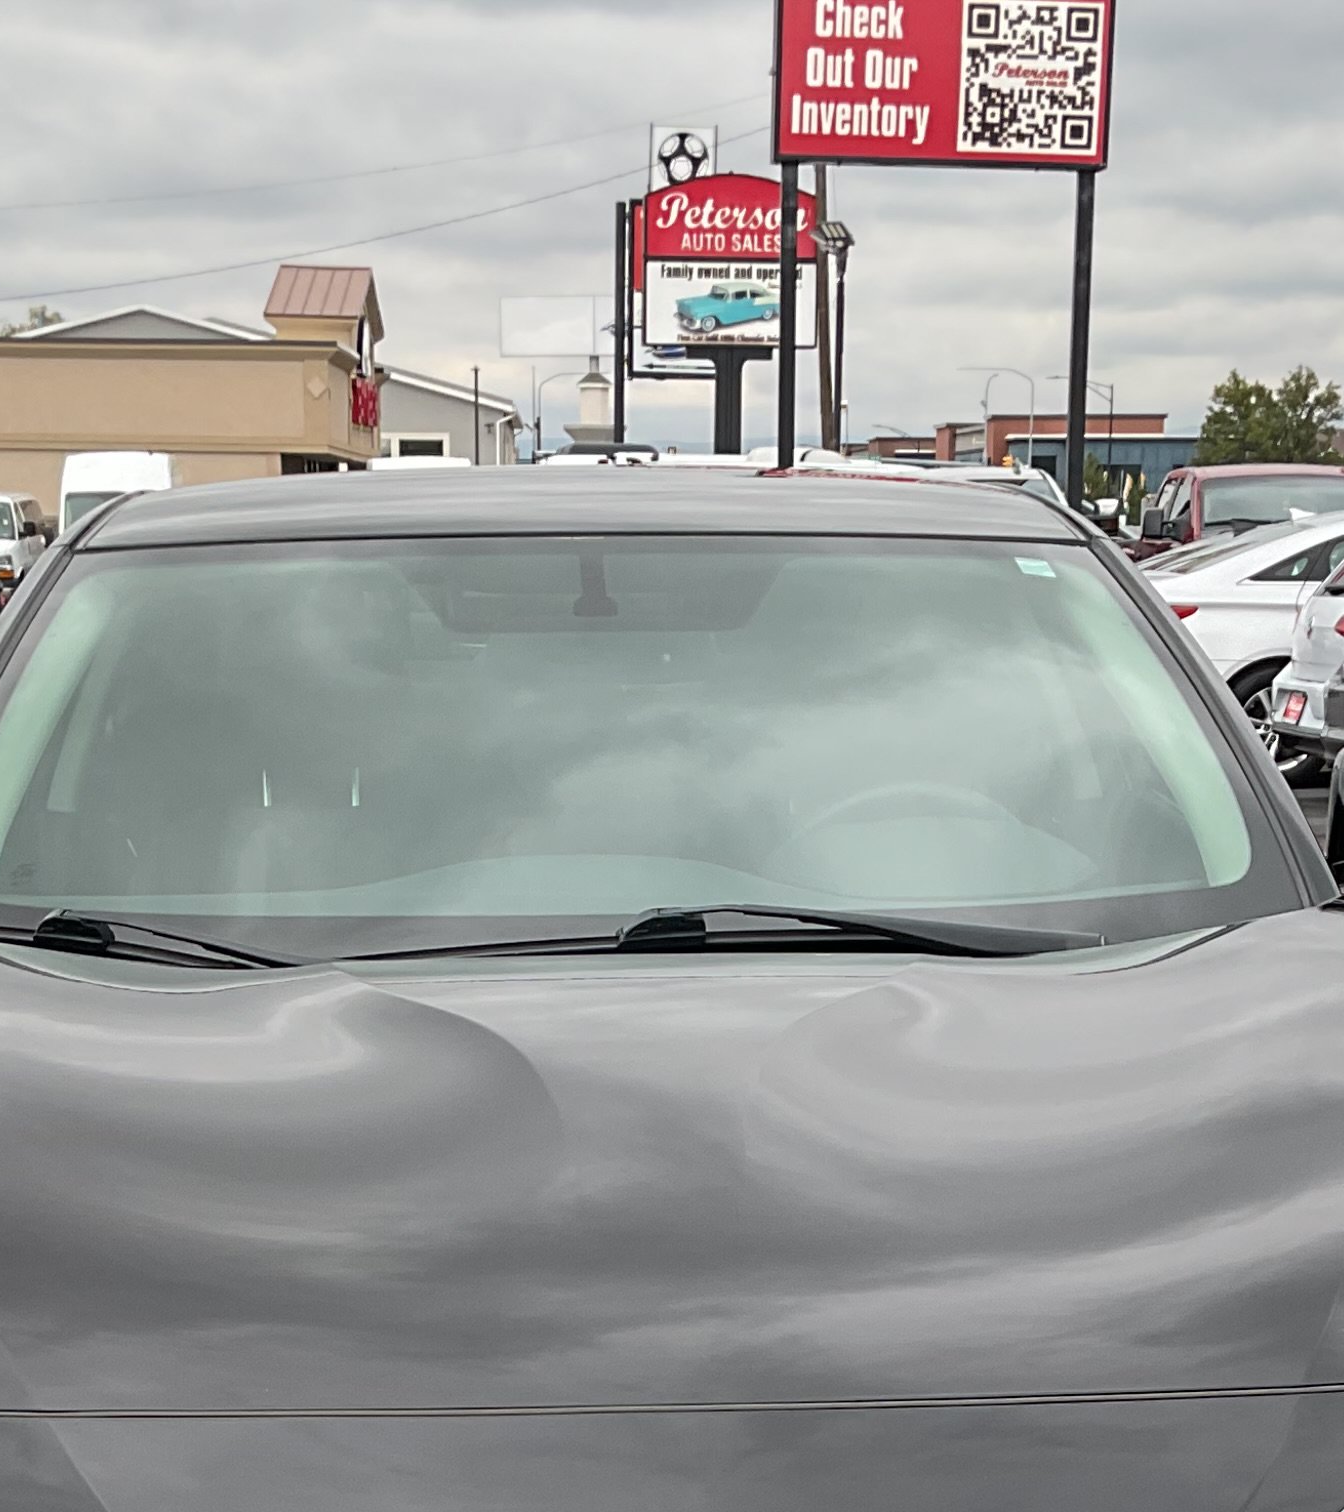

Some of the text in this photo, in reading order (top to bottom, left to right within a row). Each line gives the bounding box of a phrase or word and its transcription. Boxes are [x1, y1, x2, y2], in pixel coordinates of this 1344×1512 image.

[815, 0, 904, 39] Check
[806, 46, 918, 90] Out Our
[992, 62, 1068, 80] Peterson
[791, 93, 930, 145] Inventory
[681, 232, 726, 251] AUTO
[661, 264, 693, 281] Family
[697, 265, 730, 279] owned
[734, 266, 752, 279] and
